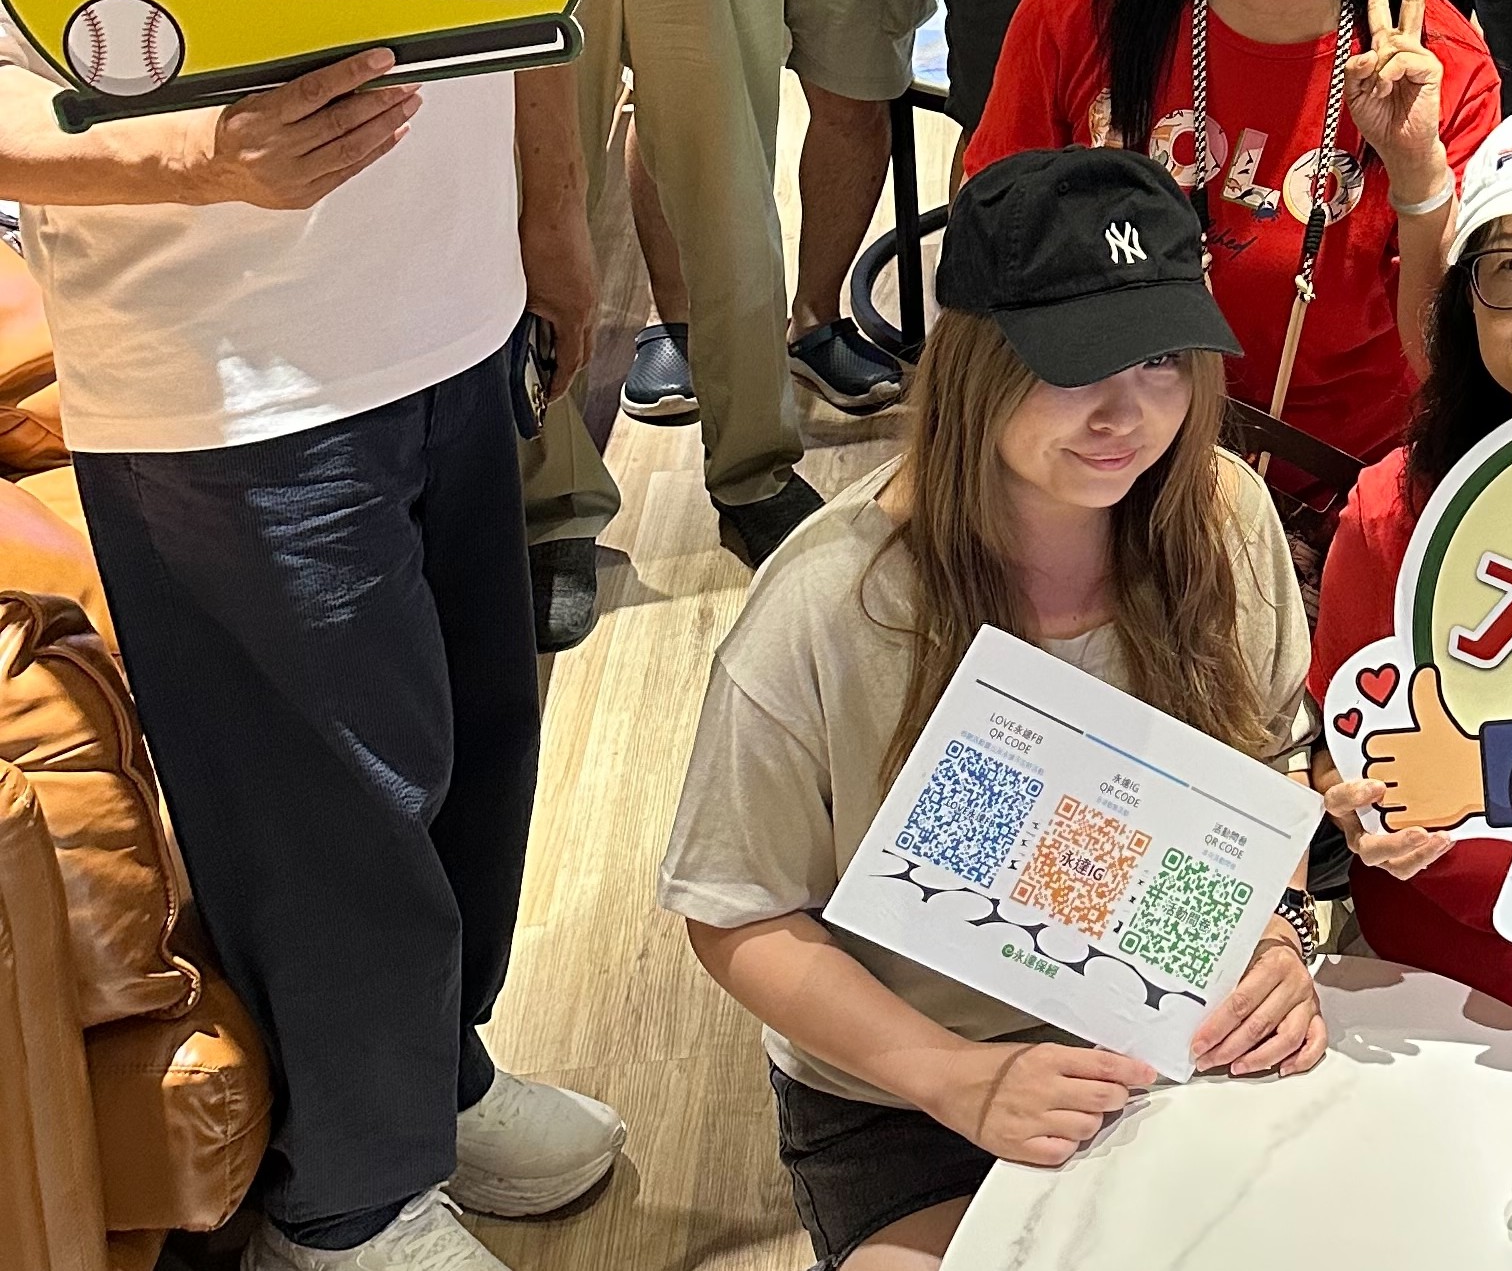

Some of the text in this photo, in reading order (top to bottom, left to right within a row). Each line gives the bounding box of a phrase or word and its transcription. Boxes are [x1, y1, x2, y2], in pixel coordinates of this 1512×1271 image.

[1104, 221, 1148, 264] NY
[989, 728, 1033, 755] QR CODE
[1100, 782, 1114, 795] QR
[1114, 789, 1142, 808] CODE
[1204, 834, 1245, 859] QR CODE
[1059, 849, 1105, 881] 永達IG
